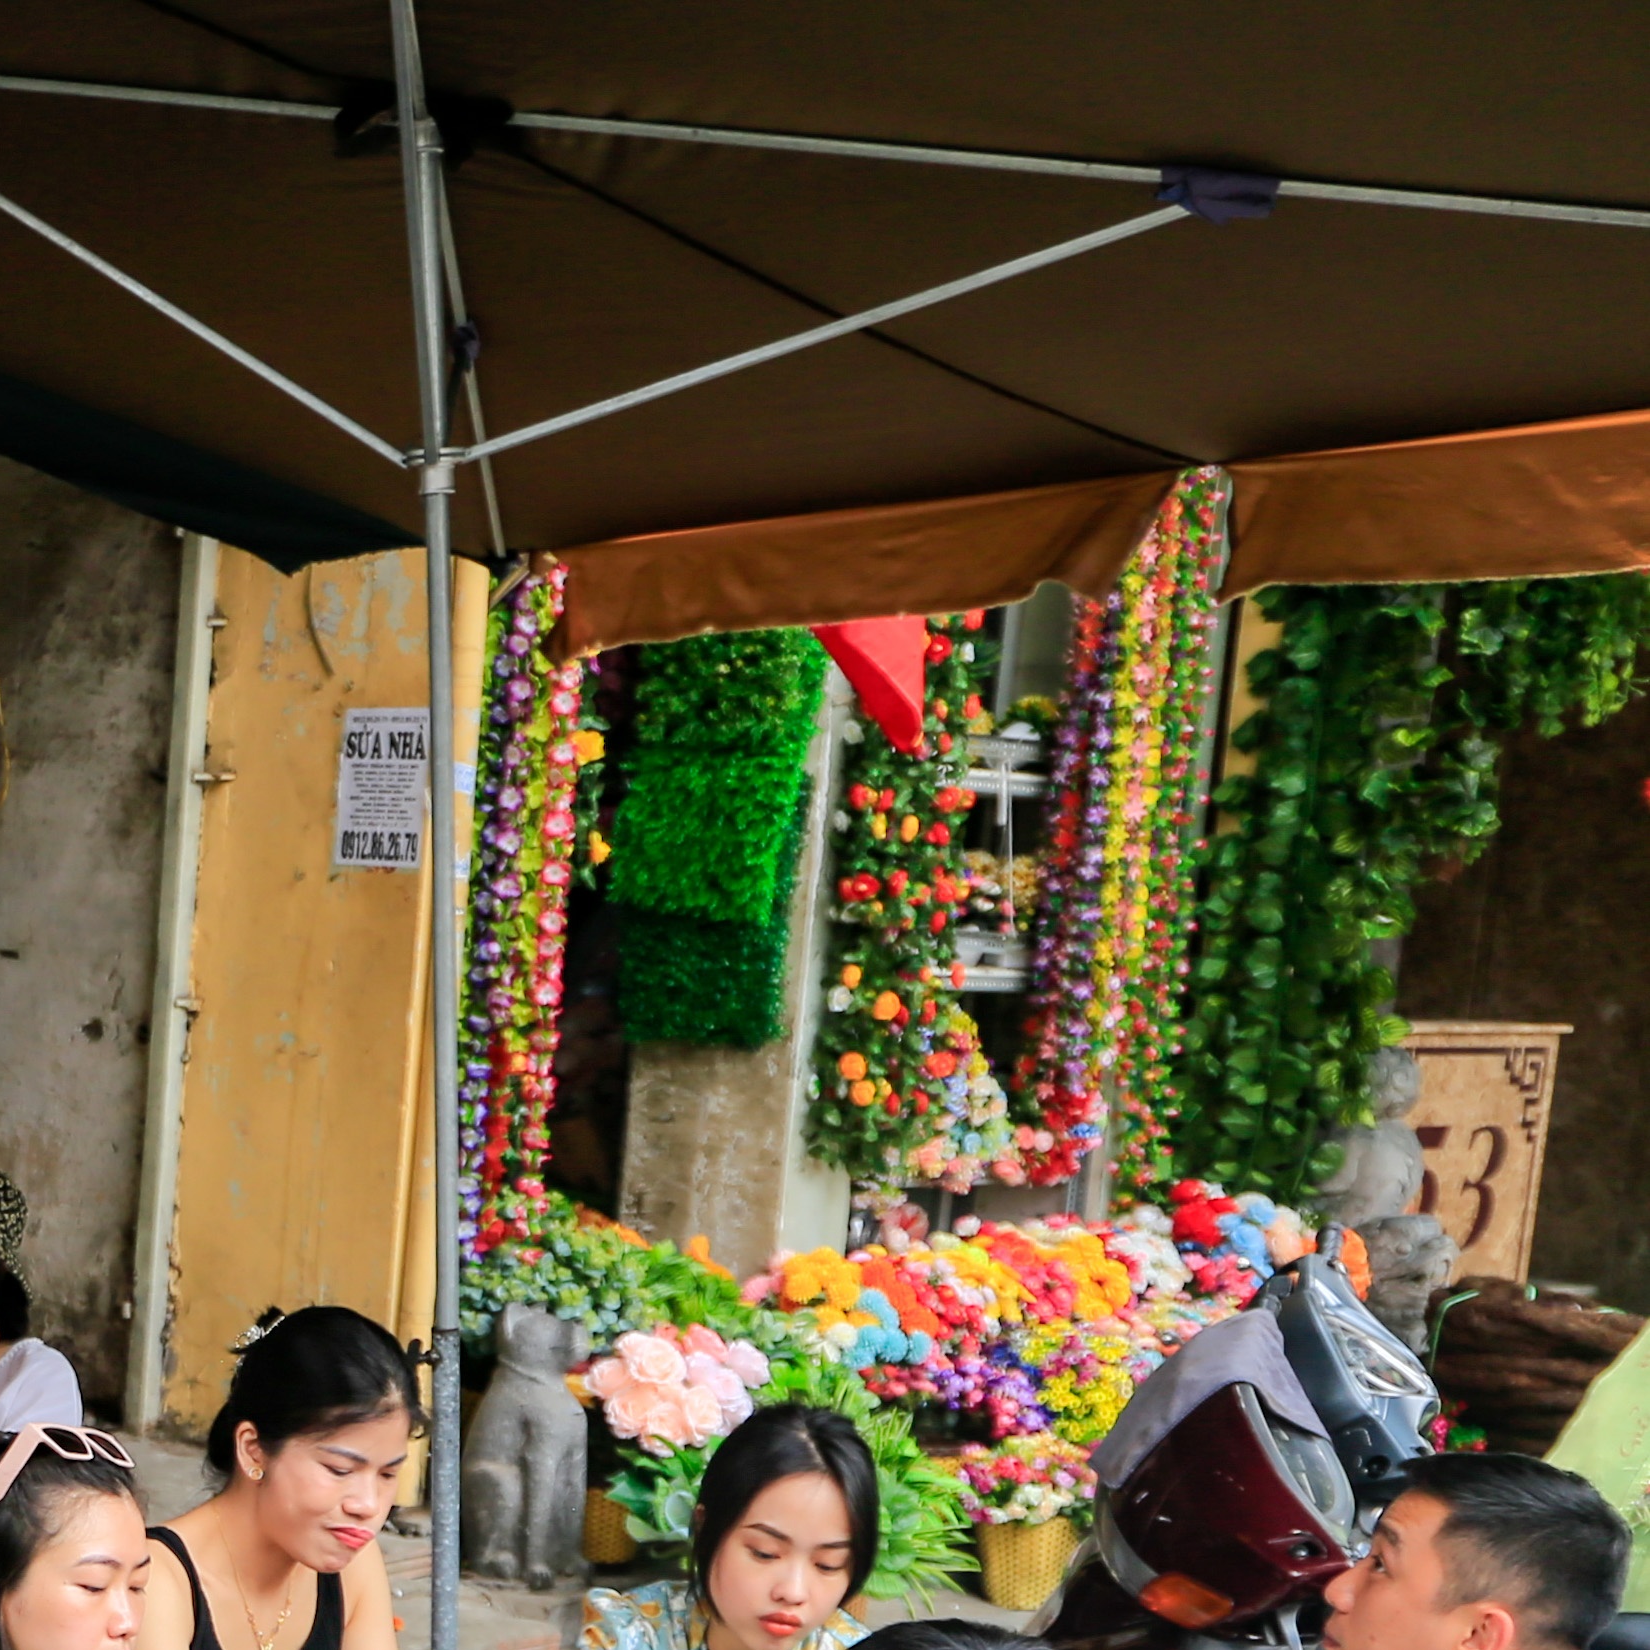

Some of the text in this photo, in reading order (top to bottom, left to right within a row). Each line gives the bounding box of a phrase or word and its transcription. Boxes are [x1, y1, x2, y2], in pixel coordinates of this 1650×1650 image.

[346, 724, 427, 760] SỬA NHÀ
[341, 829, 419, 862] 0912.86.26.79
